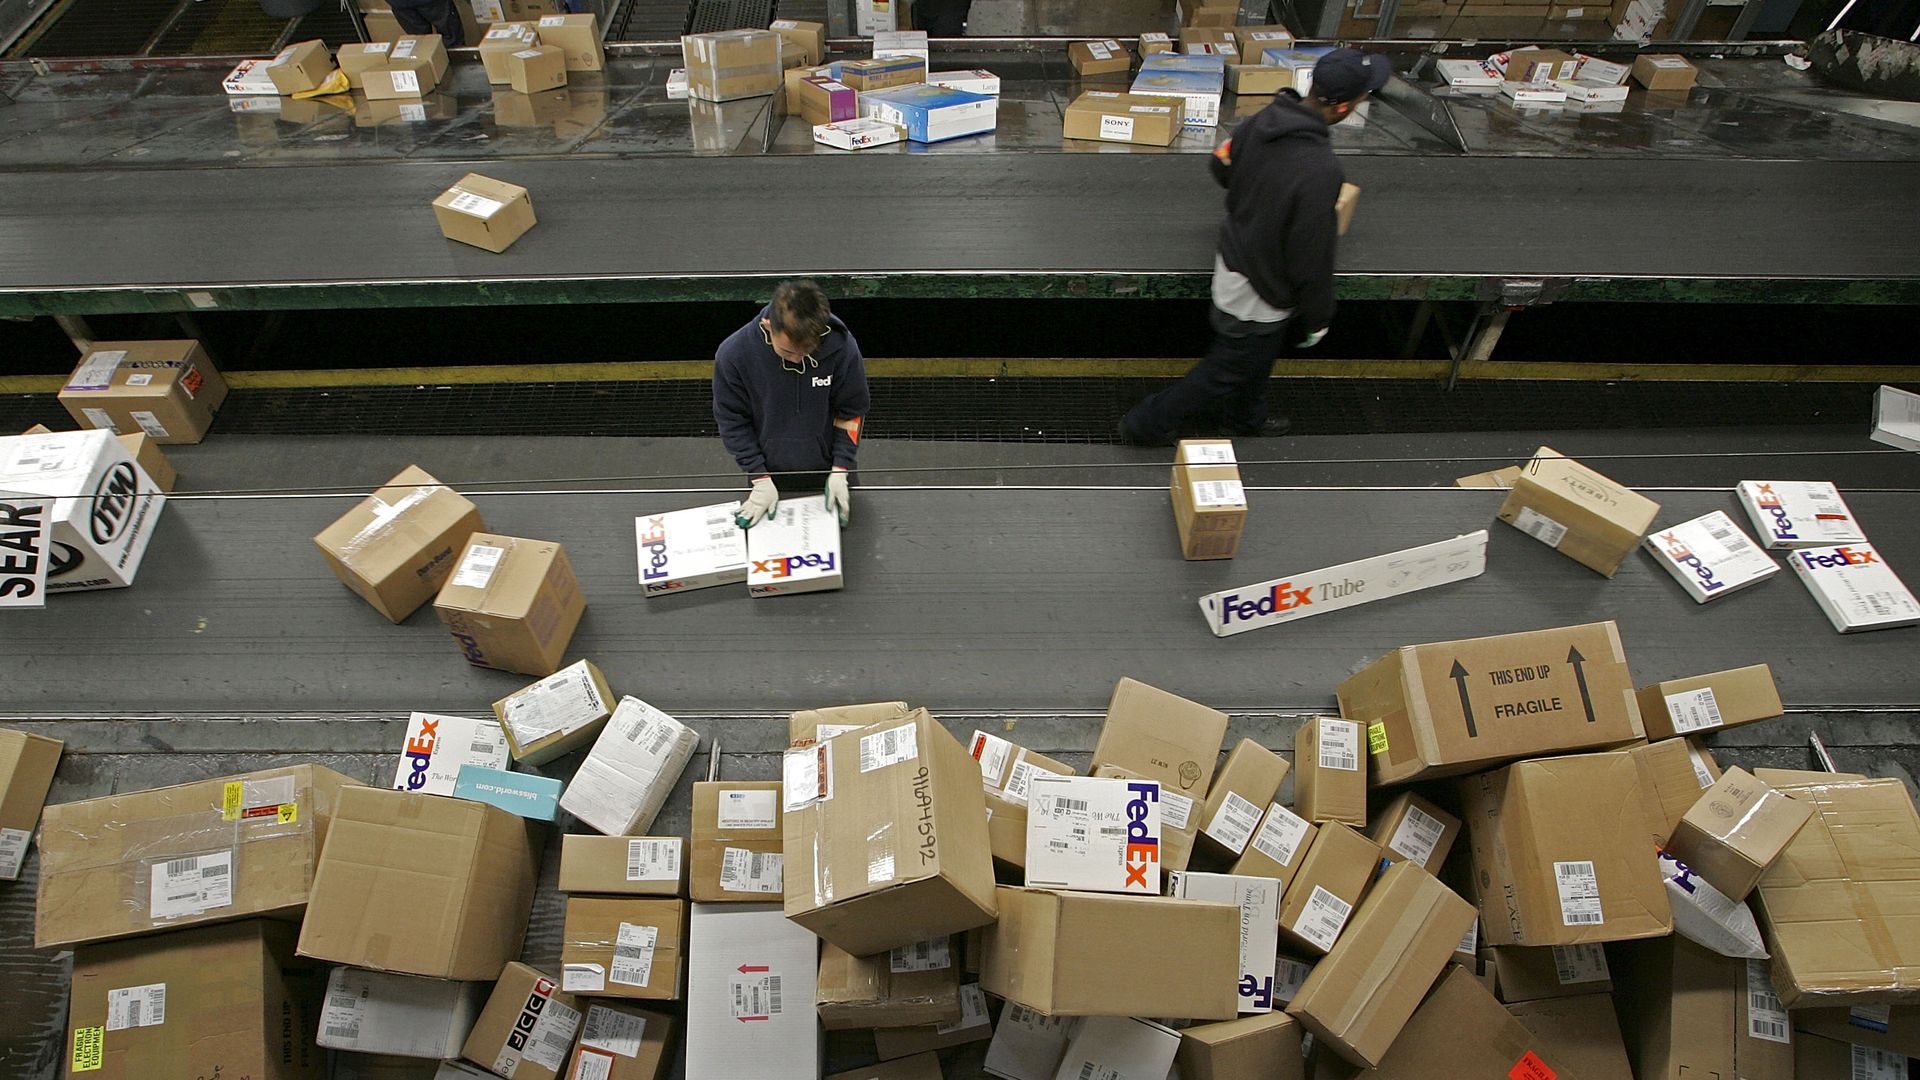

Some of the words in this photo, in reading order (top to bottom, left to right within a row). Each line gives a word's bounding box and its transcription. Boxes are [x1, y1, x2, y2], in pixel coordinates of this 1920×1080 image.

[1104, 118, 1131, 127] SONY
[851, 135, 871, 146] FedEx
[812, 375, 832, 387] Fed
[95, 469, 136, 538] JTM
[1755, 482, 1800, 540] FedEx
[641, 516, 669, 581] FedEx
[1798, 547, 1880, 570] FedEx
[752, 552, 836, 579] FedEx
[1659, 531, 1726, 592] FedEx
[647, 580, 685, 593] FedEx
[751, 585, 780, 594] FedEx
[1223, 582, 1314, 625] FedEx
[1319, 577, 1366, 602] Tube
[1488, 669, 1514, 686] THIS
[1515, 667, 1533, 683] END
[1535, 665, 1551, 680] UP
[1494, 697, 1563, 719] FRAGILE
[398, 718, 440, 791] edEx
[475, 783, 538, 801] blissworld.com
[1125, 782, 1159, 889] FedEx
[282, 1000, 291, 1015] UP
[283, 1018, 292, 1039] END
[75, 1029, 85, 1063] FRAGILE
[283, 1041, 292, 1065] THIS
